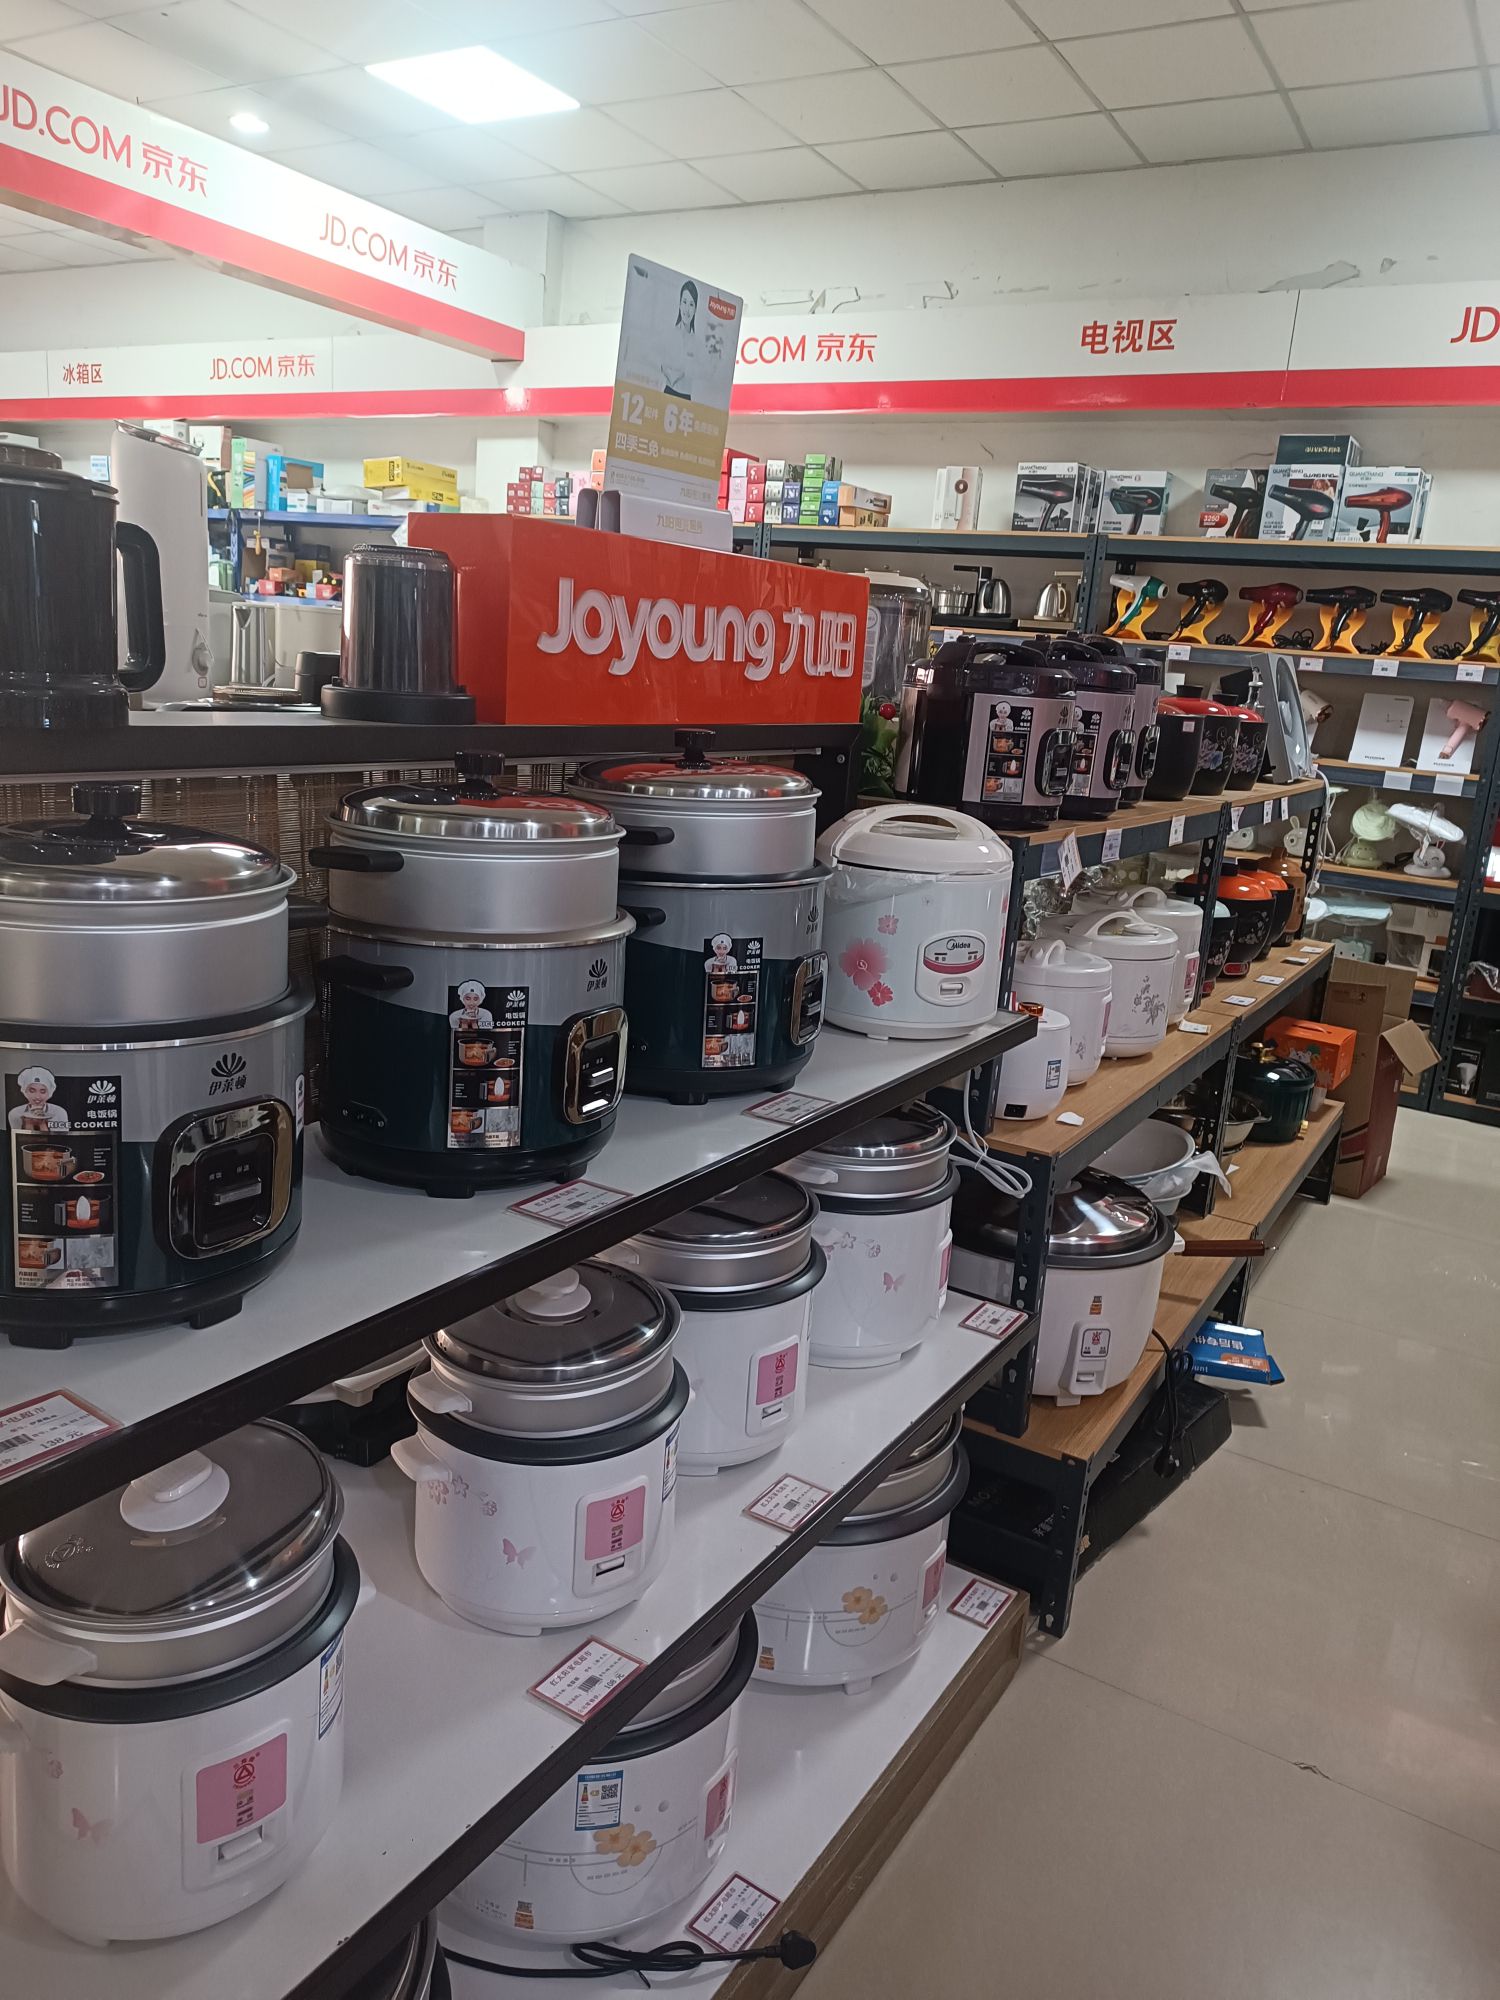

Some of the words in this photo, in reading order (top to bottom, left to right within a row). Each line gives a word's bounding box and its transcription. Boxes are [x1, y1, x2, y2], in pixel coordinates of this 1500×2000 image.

[141, 141, 208, 198] 京东
[319, 212, 409, 272] JD.COM
[413, 249, 458, 291] 京东
[816, 332, 878, 363] 京东
[1080, 318, 1178, 355] 电视区
[62, 362, 104, 386] 冰箱区
[209, 355, 273, 381] JD.COM
[277, 354, 316, 378] 京东
[536, 576, 777, 682] Joyoung
[778, 606, 857, 678] 九阳
[946, 938, 971, 951] Midea
[74, 1120, 118, 1128] COOKER
[87, 1109, 118, 1119] 电饭锅
[40, 1436, 65, 1449] 138
